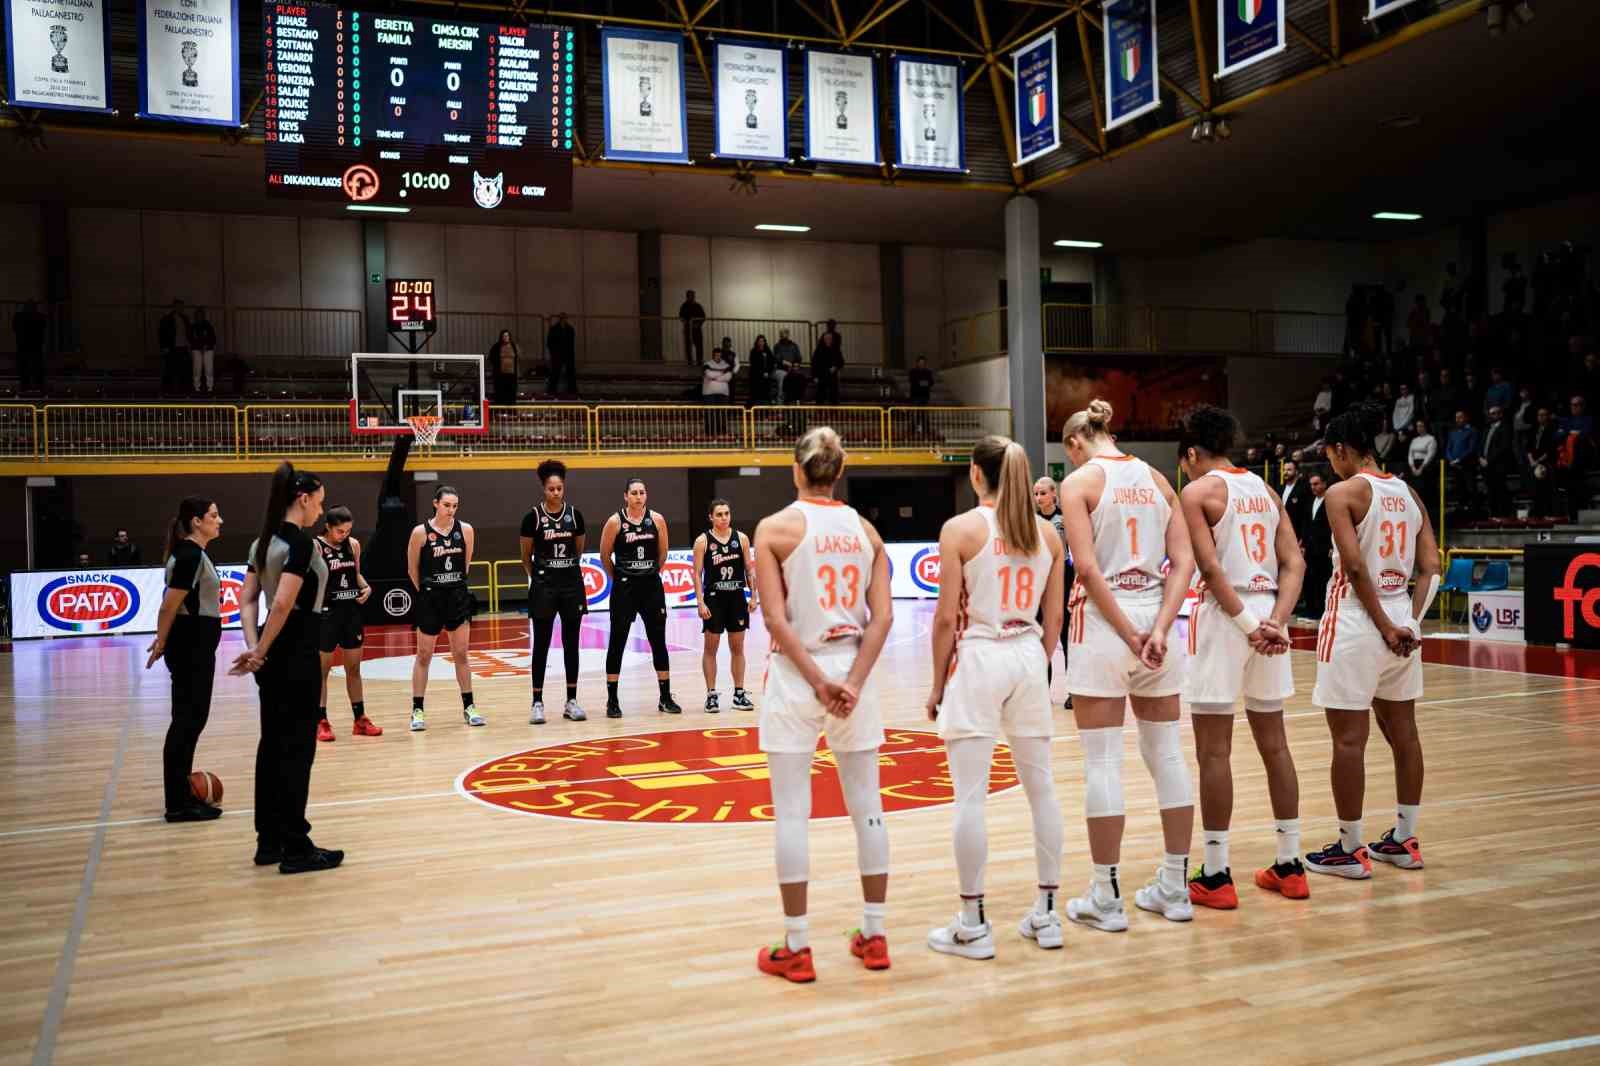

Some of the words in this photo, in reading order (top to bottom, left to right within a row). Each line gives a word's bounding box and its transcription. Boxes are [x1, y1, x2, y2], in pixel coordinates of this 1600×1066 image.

[276, 4, 306, 16] PLAYER
[276, 15, 307, 27] JUHASZ
[336, 20, 343, 30] 0
[352, 22, 359, 32] 0
[375, 19, 414, 32] BERETTA
[277, 27, 318, 40] BESTAGNO
[337, 32, 343, 42] 0
[352, 33, 359, 43] 0
[499, 25, 527, 37] PLAYER
[378, 32, 411, 46] FAMILA
[438, 38, 472, 51] MERSIN
[277, 39, 313, 51] SOTTANA
[337, 44, 343, 53] 0
[353, 45, 360, 55] 0
[277, 50, 313, 63] ZANARDI
[337, 56, 343, 65] 0
[353, 56, 360, 66] 0
[277, 62, 311, 74] VERONA
[337, 67, 343, 76] 0
[353, 68, 360, 78] 0
[337, 79, 344, 88] 0
[353, 80, 360, 89] 0
[391, 68, 404, 87] 0
[447, 72, 460, 91] 0
[337, 90, 344, 100] 0
[353, 91, 360, 101] 0
[338, 102, 344, 111] 0
[353, 103, 360, 112] 0
[394, 106, 402, 117] 0
[338, 113, 344, 122] 0
[353, 114, 360, 124] 0
[450, 109, 458, 120] 0
[279, 121, 299, 131] KEYS
[338, 125, 344, 134] 0
[354, 125, 361, 135] 0
[279, 133, 304, 143] LAKSA
[338, 136, 344, 145] 0
[354, 137, 361, 147] 0
[269, 174, 282, 184] ALL
[283, 174, 342, 187] DIKAIOULAKOS
[402, 172, 450, 190] 10:00
[506, 186, 520, 195] ALL
[395, 281, 432, 293] 10:00
[392, 296, 432, 320] 24
[1381, 496, 1406, 512] KEYS
[816, 536, 862, 553] LAKSA
[1126, 516, 1137, 560] 1
[1240, 523, 1266, 563] 13
[1379, 521, 1407, 560] 31
[554, 543, 566, 557] 12
[445, 556, 452, 570] 6
[67, 574, 110, 585] SNACK
[660, 568, 694, 587] ATA
[720, 566, 733, 580] 99
[817, 563, 861, 611] 33
[996, 566, 1035, 611] 18
[59, 591, 118, 613] PATA
[1496, 608, 1520, 625] LBF
